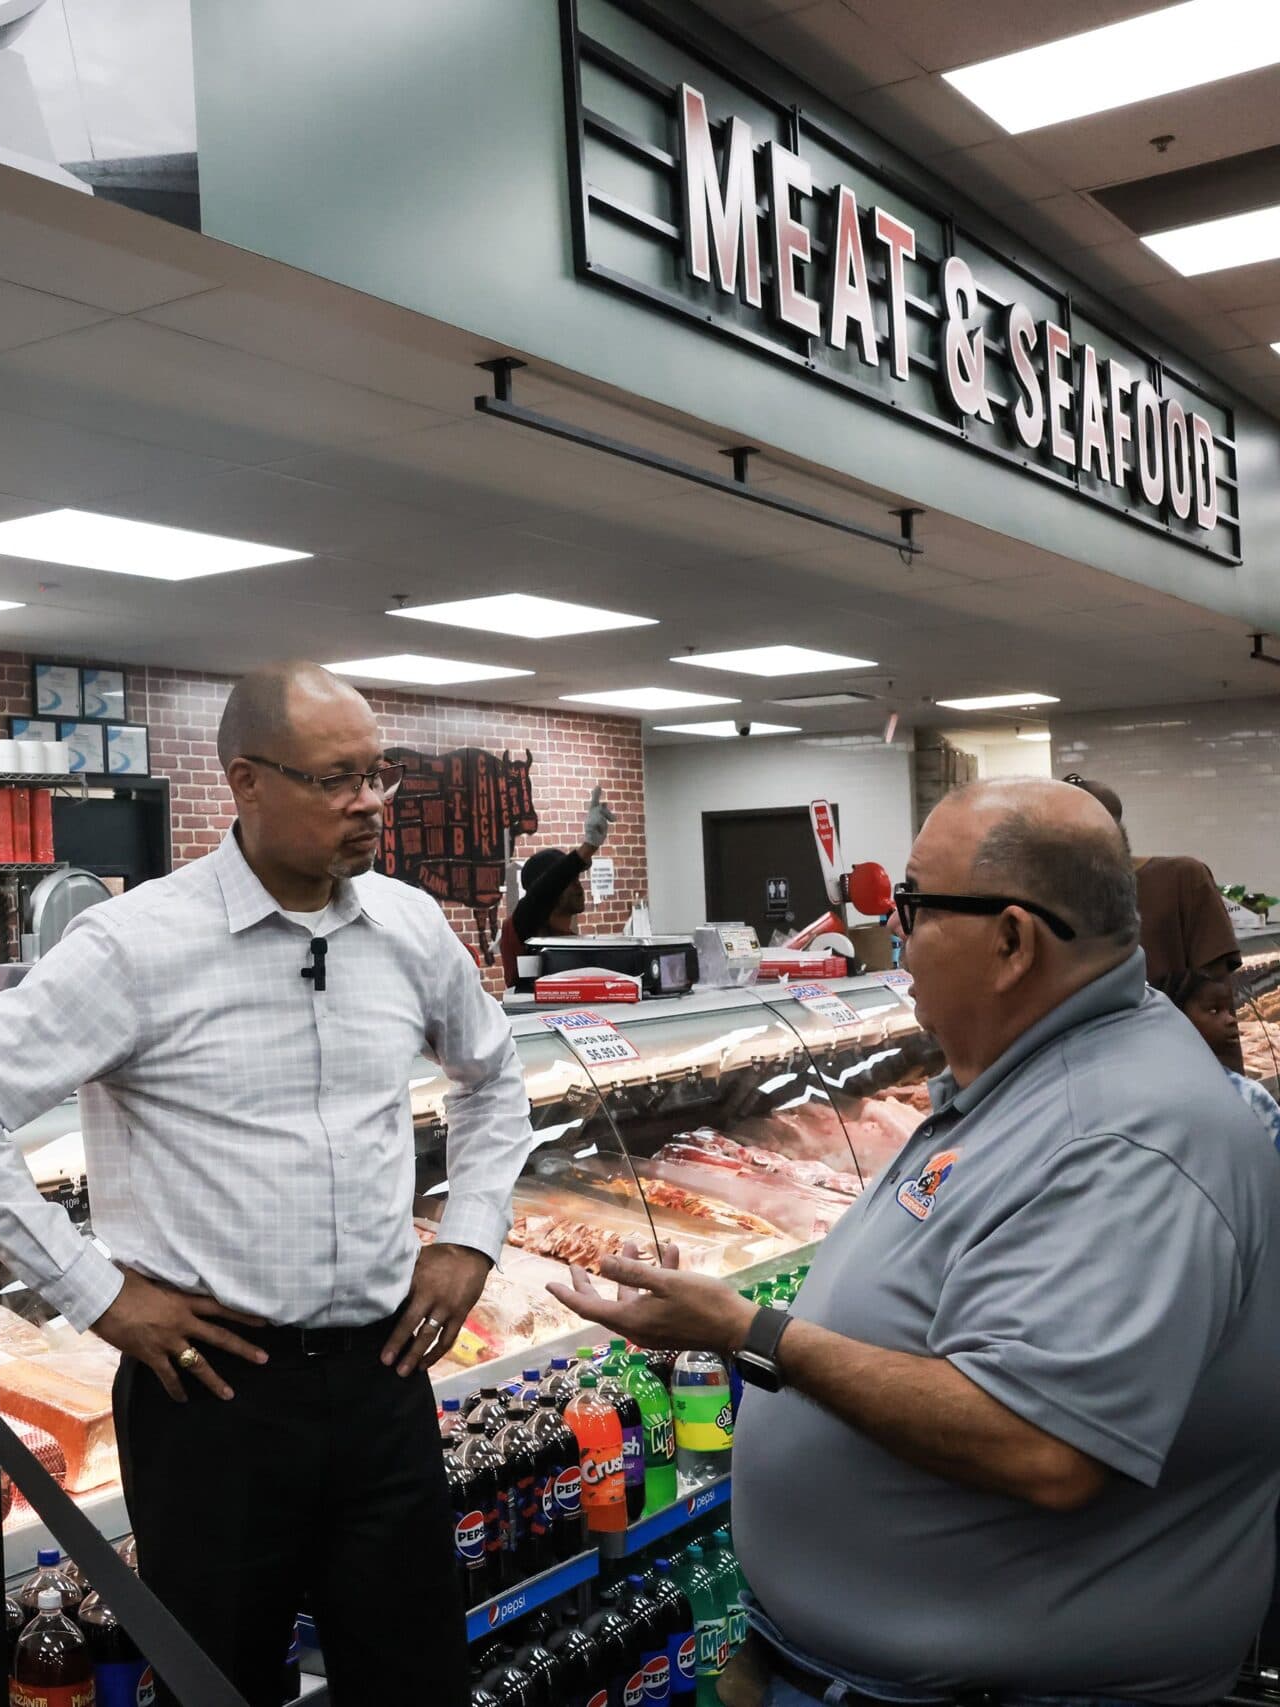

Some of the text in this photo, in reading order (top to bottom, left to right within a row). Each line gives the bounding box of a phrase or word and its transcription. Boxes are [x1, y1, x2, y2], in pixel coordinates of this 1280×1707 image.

[677, 82, 1218, 531] MEAT & SEAFOOD
[580, 1455, 624, 1484] Crus
[556, 1482, 582, 1496] PEPS
[696, 1490, 715, 1511] pepsi
[457, 1526, 486, 1543] PEPS
[501, 1593, 526, 1622] pepsi
[642, 1671, 670, 1685] PEPS
